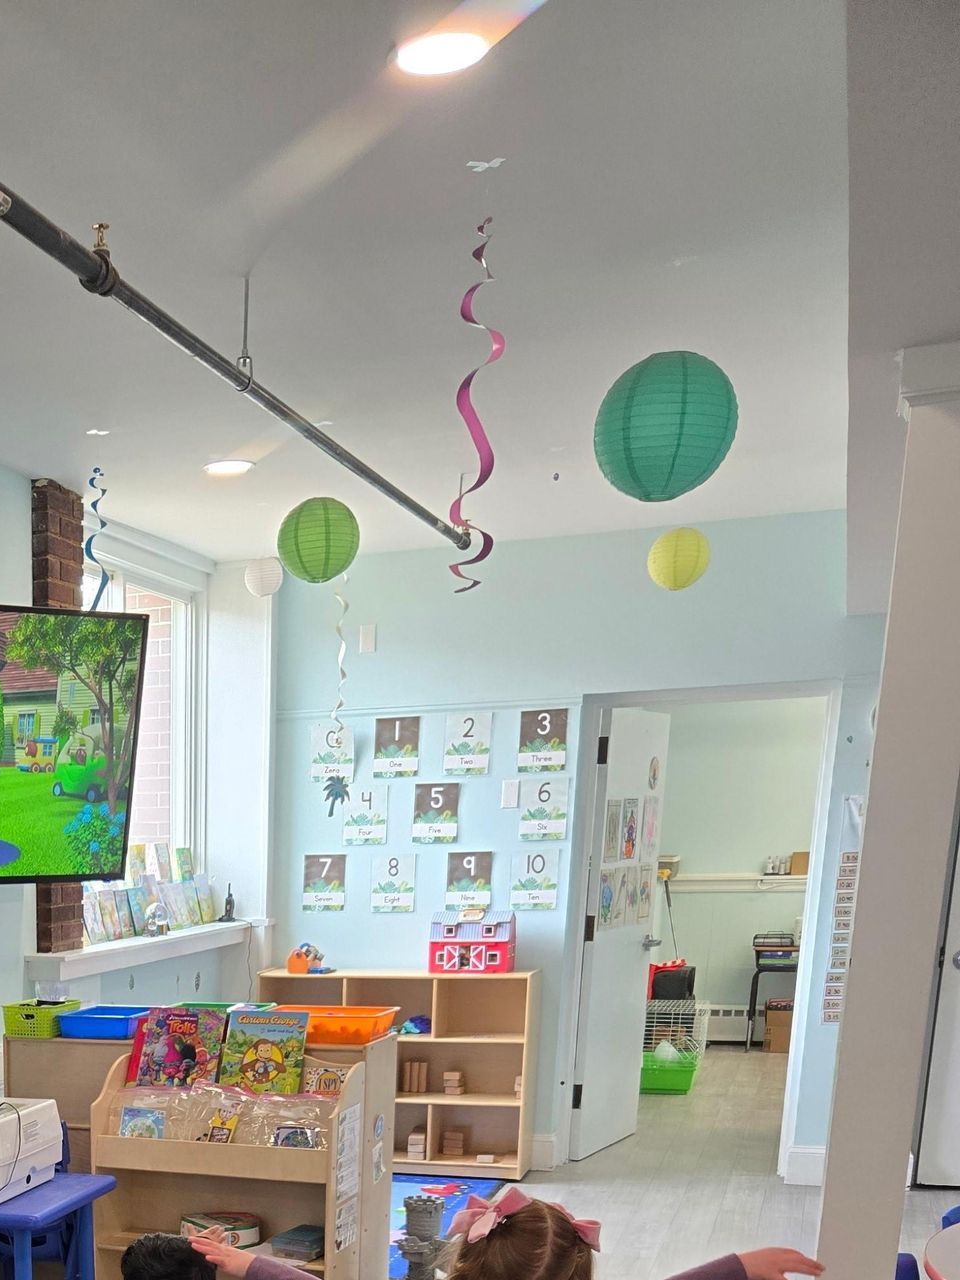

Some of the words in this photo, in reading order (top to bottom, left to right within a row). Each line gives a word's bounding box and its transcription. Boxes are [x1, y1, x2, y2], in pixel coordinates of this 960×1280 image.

[394, 721, 400, 741] 1
[463, 718, 475, 738] 2
[537, 713, 551, 735] 3
[531, 754, 552, 763] Three
[361, 791, 372, 810] 4
[430, 788, 444, 808] 5
[538, 782, 551, 802] 6
[358, 828, 373, 836] Four
[537, 823, 548, 831] Six
[319, 858, 332, 878] 7
[388, 858, 399, 877] 8
[463, 856, 475, 876] 9
[526, 854, 545, 874] 10
[314, 895, 333, 903] Seven
[384, 896, 400, 905] Eight
[460, 894, 475, 902] Nine
[528, 893, 539, 901] Ten
[166, 1019, 197, 1034] Trolls
[237, 1015, 270, 1025] Curious
[271, 1015, 300, 1026] George
[323, 1078, 337, 1090] SPY
